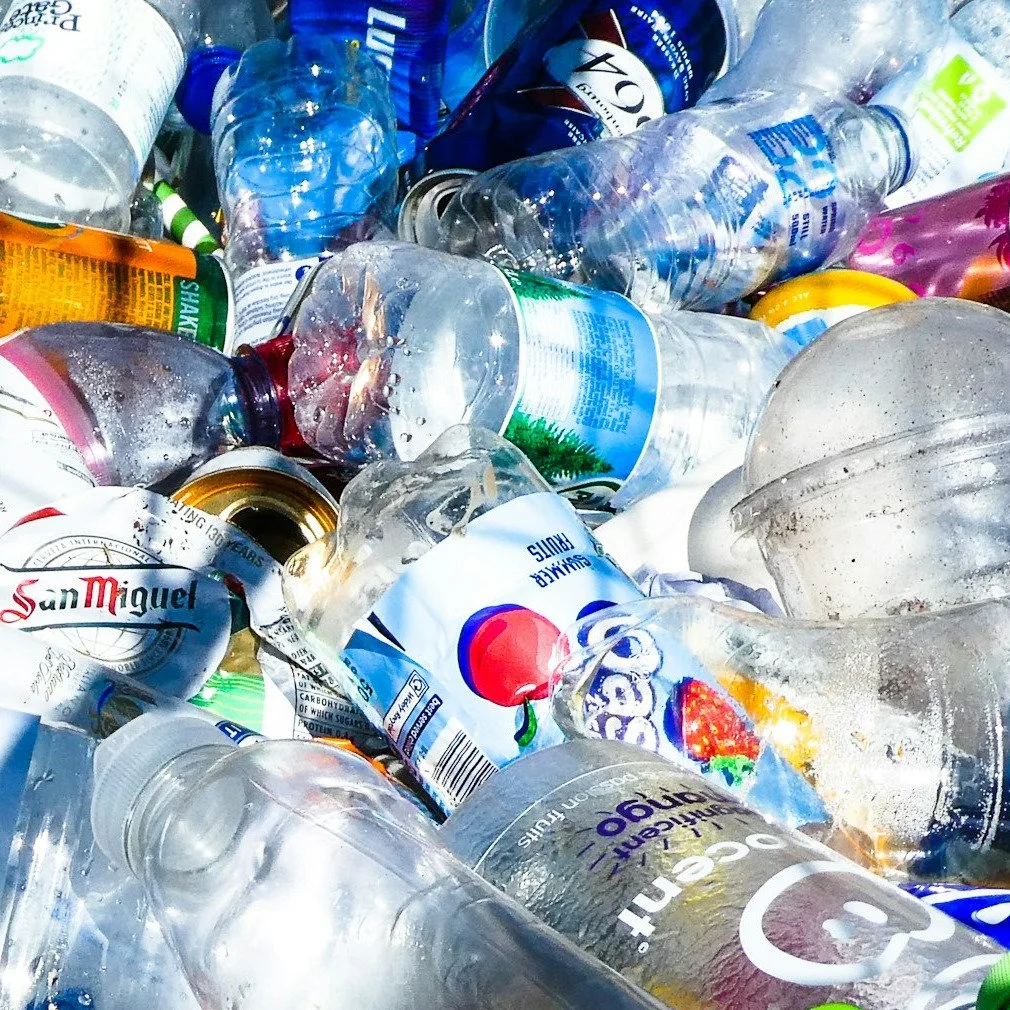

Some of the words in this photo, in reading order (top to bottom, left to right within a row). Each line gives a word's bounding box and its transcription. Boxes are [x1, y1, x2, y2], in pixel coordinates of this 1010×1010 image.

[526, 532, 578, 564] FRUITS
[528, 553, 593, 589] SUMMER
[79, 575, 197, 617] Miguel
[422, 695, 441, 718] best
[409, 713, 430, 740] served
[515, 803, 575, 850] fruits
